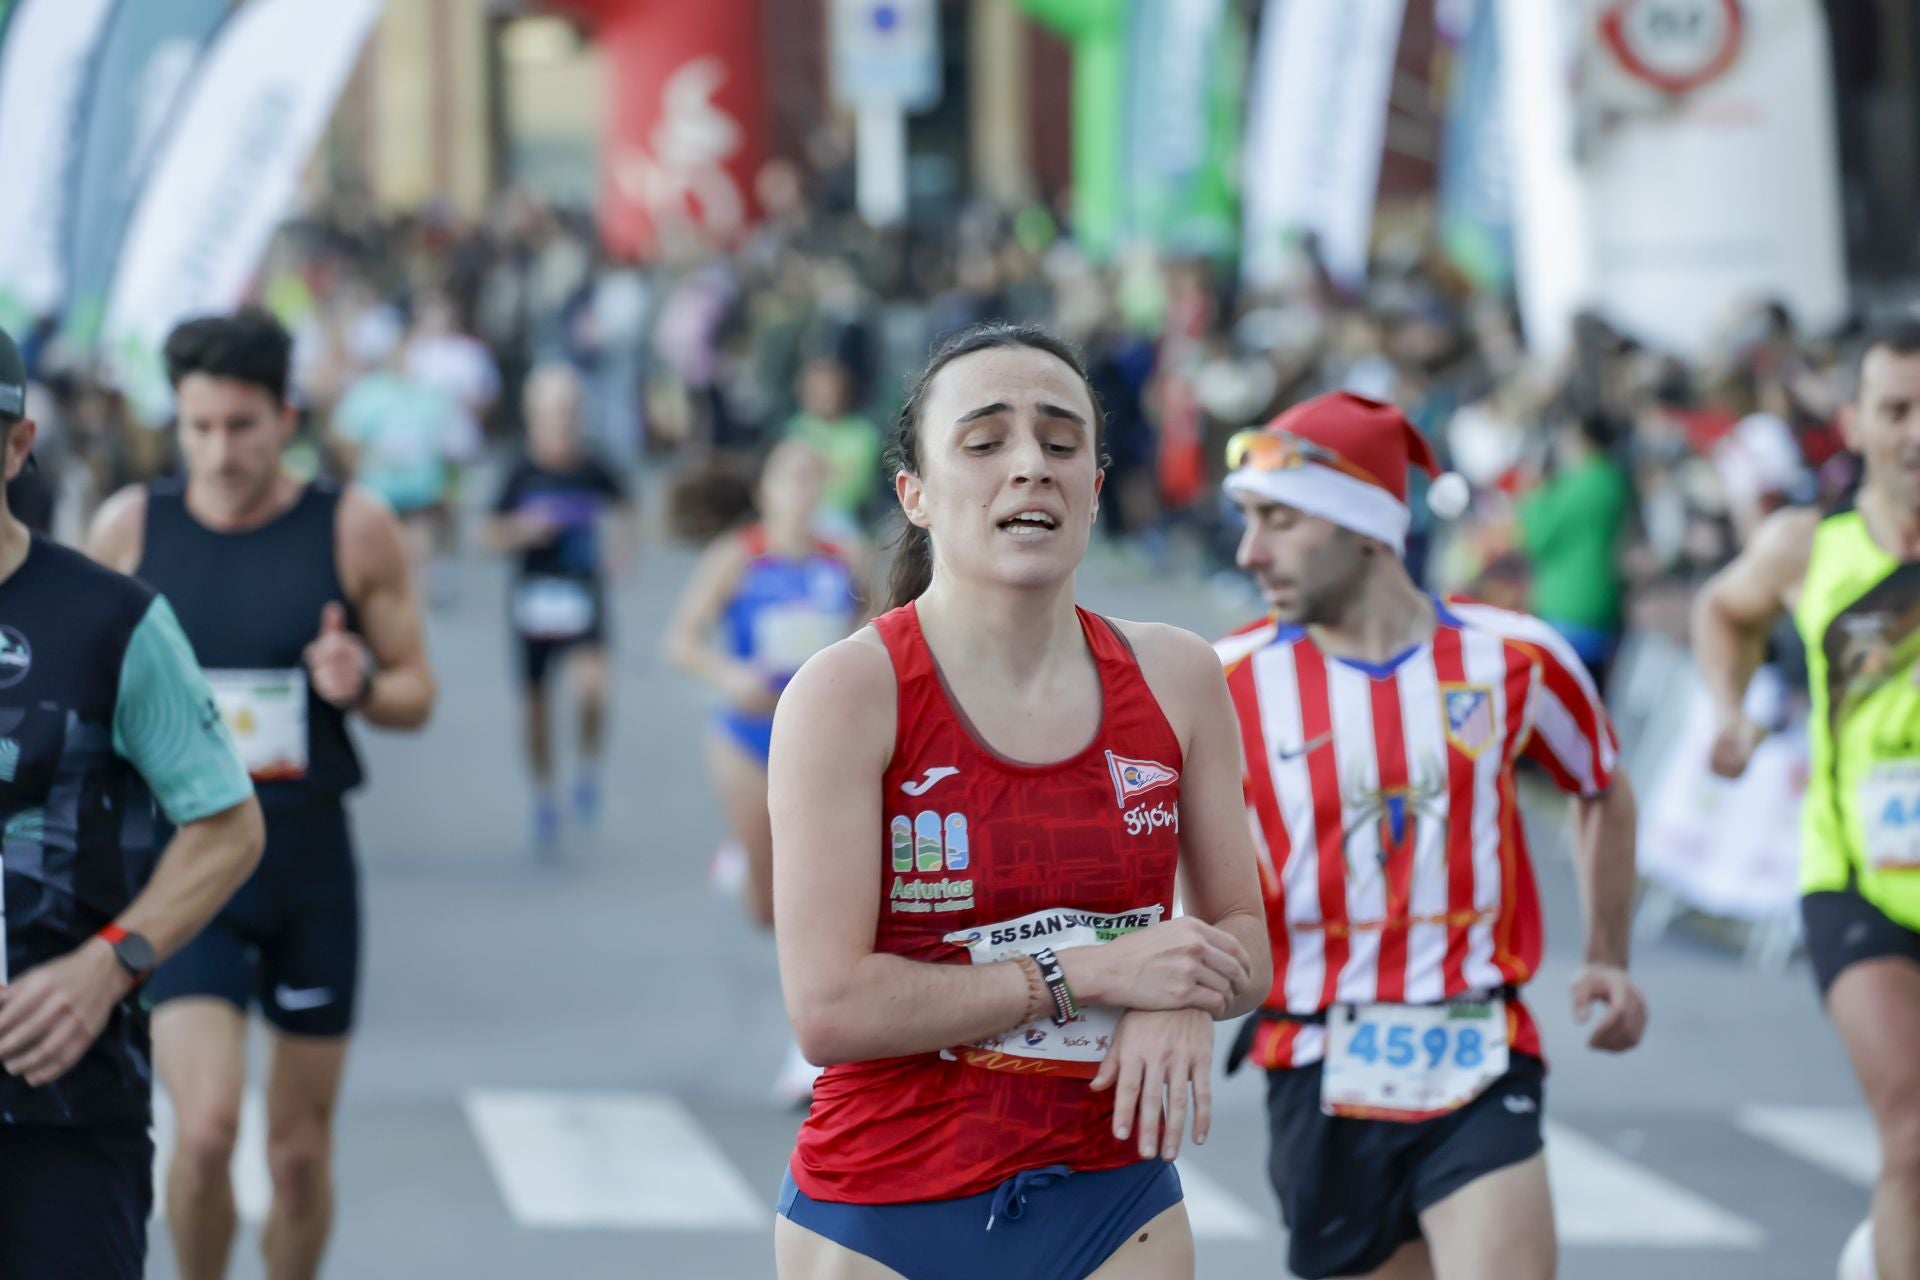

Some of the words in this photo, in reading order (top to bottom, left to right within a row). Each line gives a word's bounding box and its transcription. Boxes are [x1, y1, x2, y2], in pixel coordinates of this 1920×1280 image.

[890, 876, 974, 900] Asturias
[990, 928, 1017, 946] 55
[1019, 915, 1062, 941] SAN
[1348, 1023, 1484, 1068] 4598
